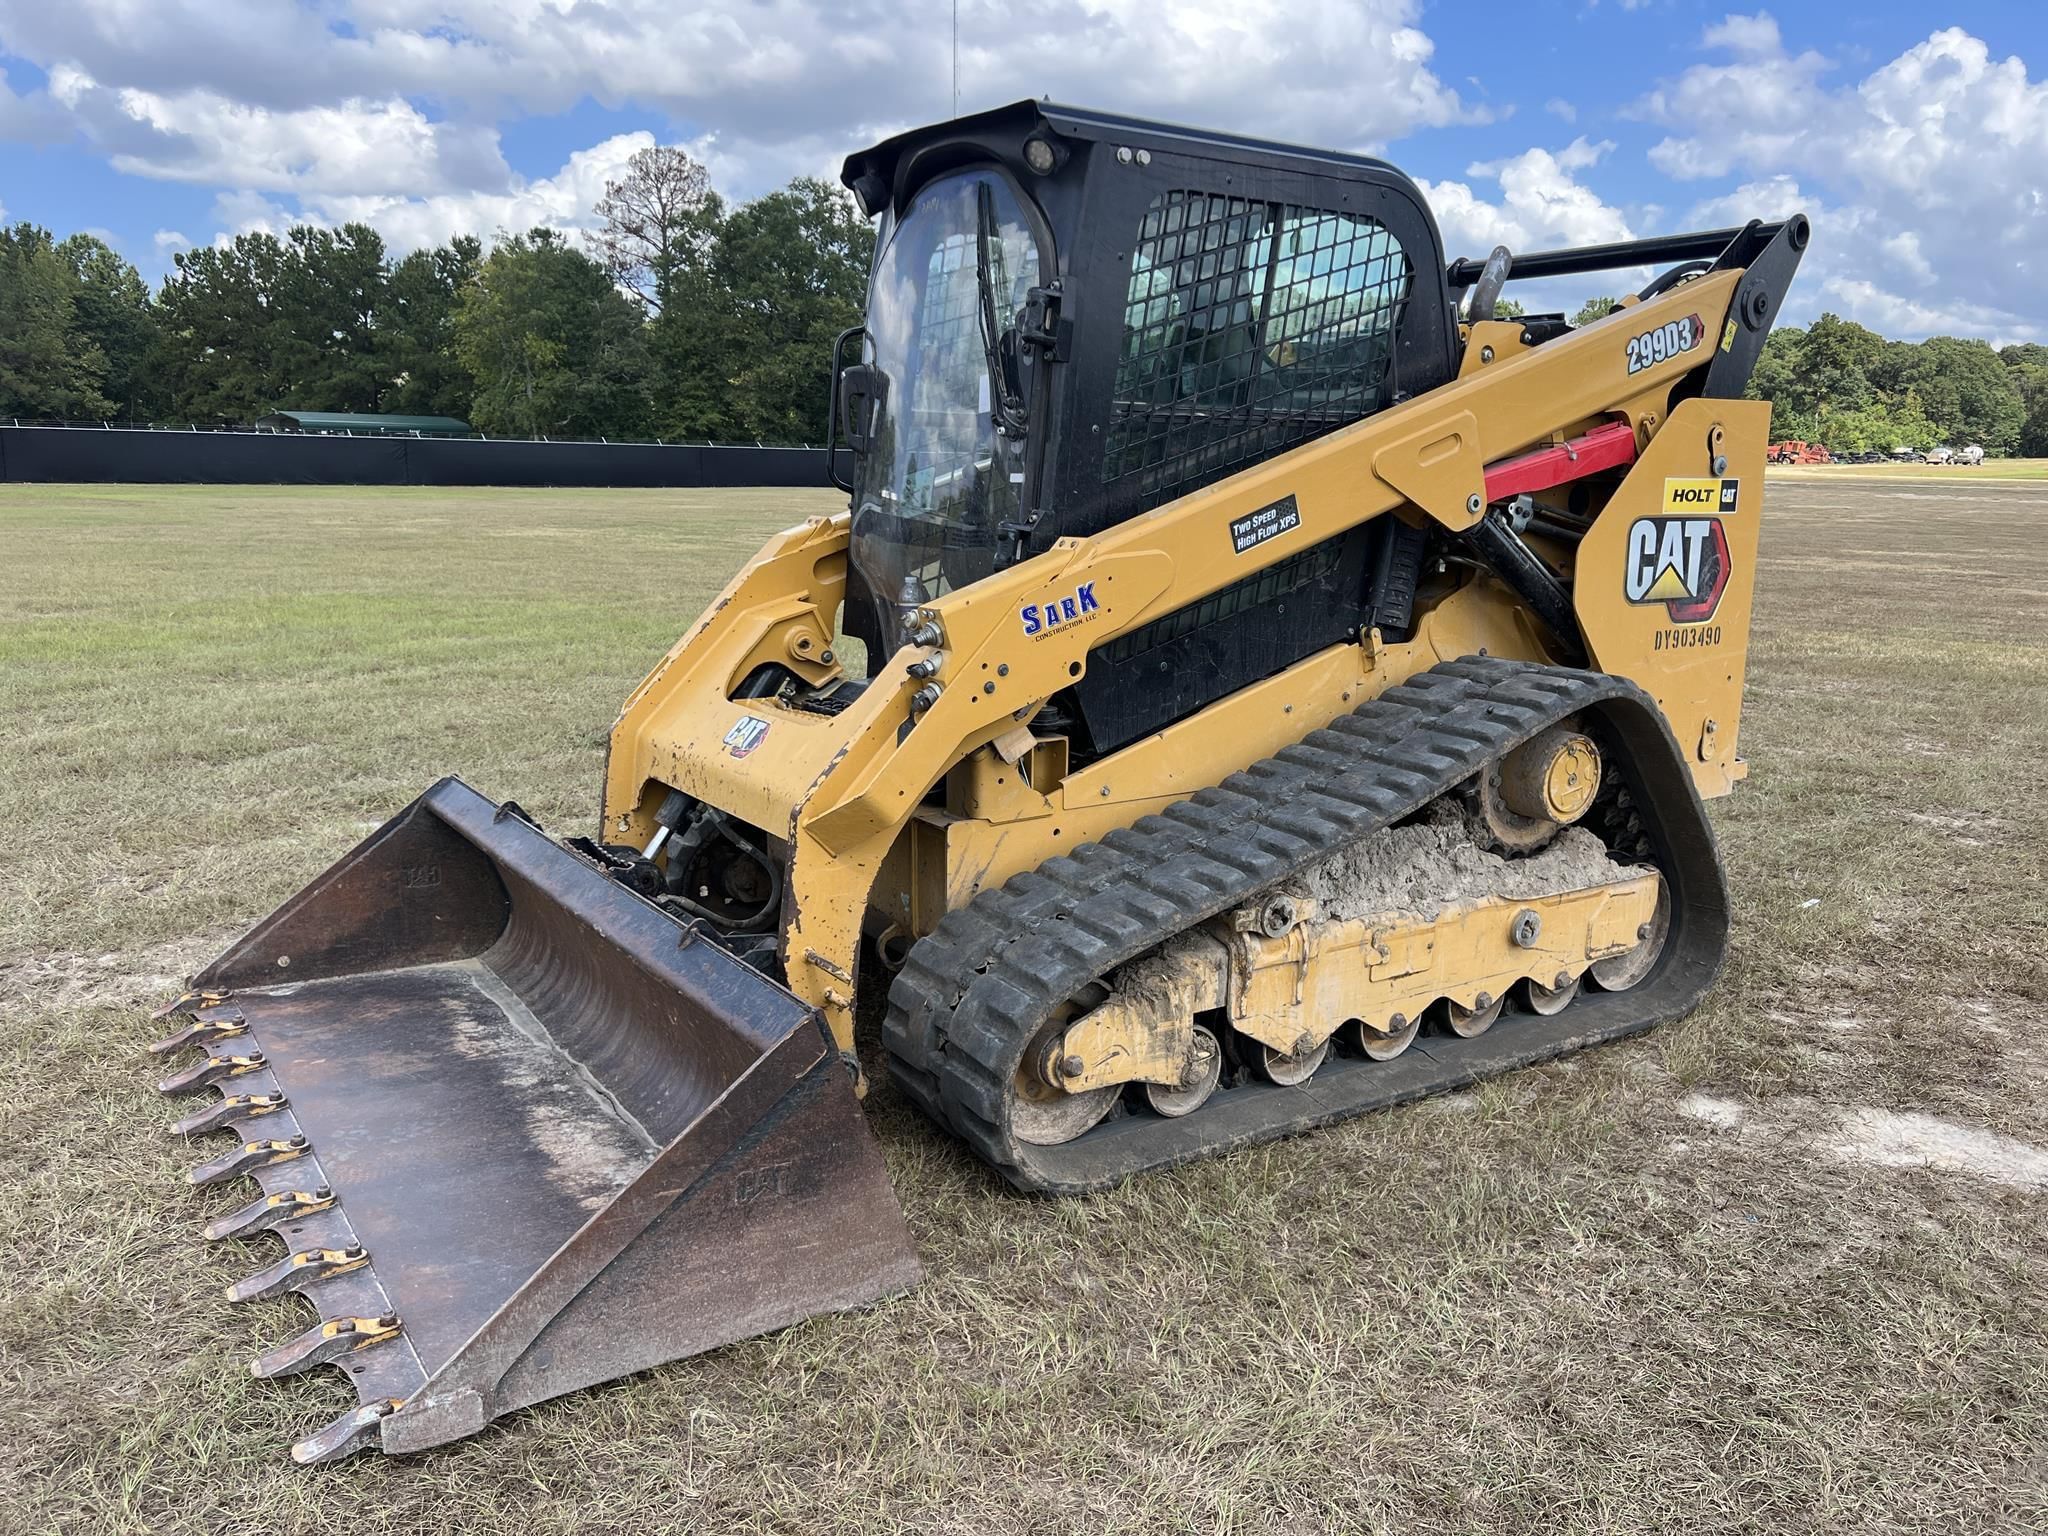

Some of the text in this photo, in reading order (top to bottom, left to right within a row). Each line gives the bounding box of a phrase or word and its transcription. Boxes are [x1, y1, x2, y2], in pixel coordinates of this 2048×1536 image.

[1627, 318, 1692, 373] 299D3
[1672, 488, 1736, 502] HOLT CAT
[1233, 509, 1276, 536] TWO SPEED
[1237, 512, 1296, 550] HIGH FLOW XPS
[1626, 519, 1710, 601] CAT
[1021, 581, 1099, 636] SARK
[1035, 613, 1097, 642] CONSTRUCTION LLC
[1654, 626, 1721, 650] DY903490
[723, 716, 767, 750] CAT
